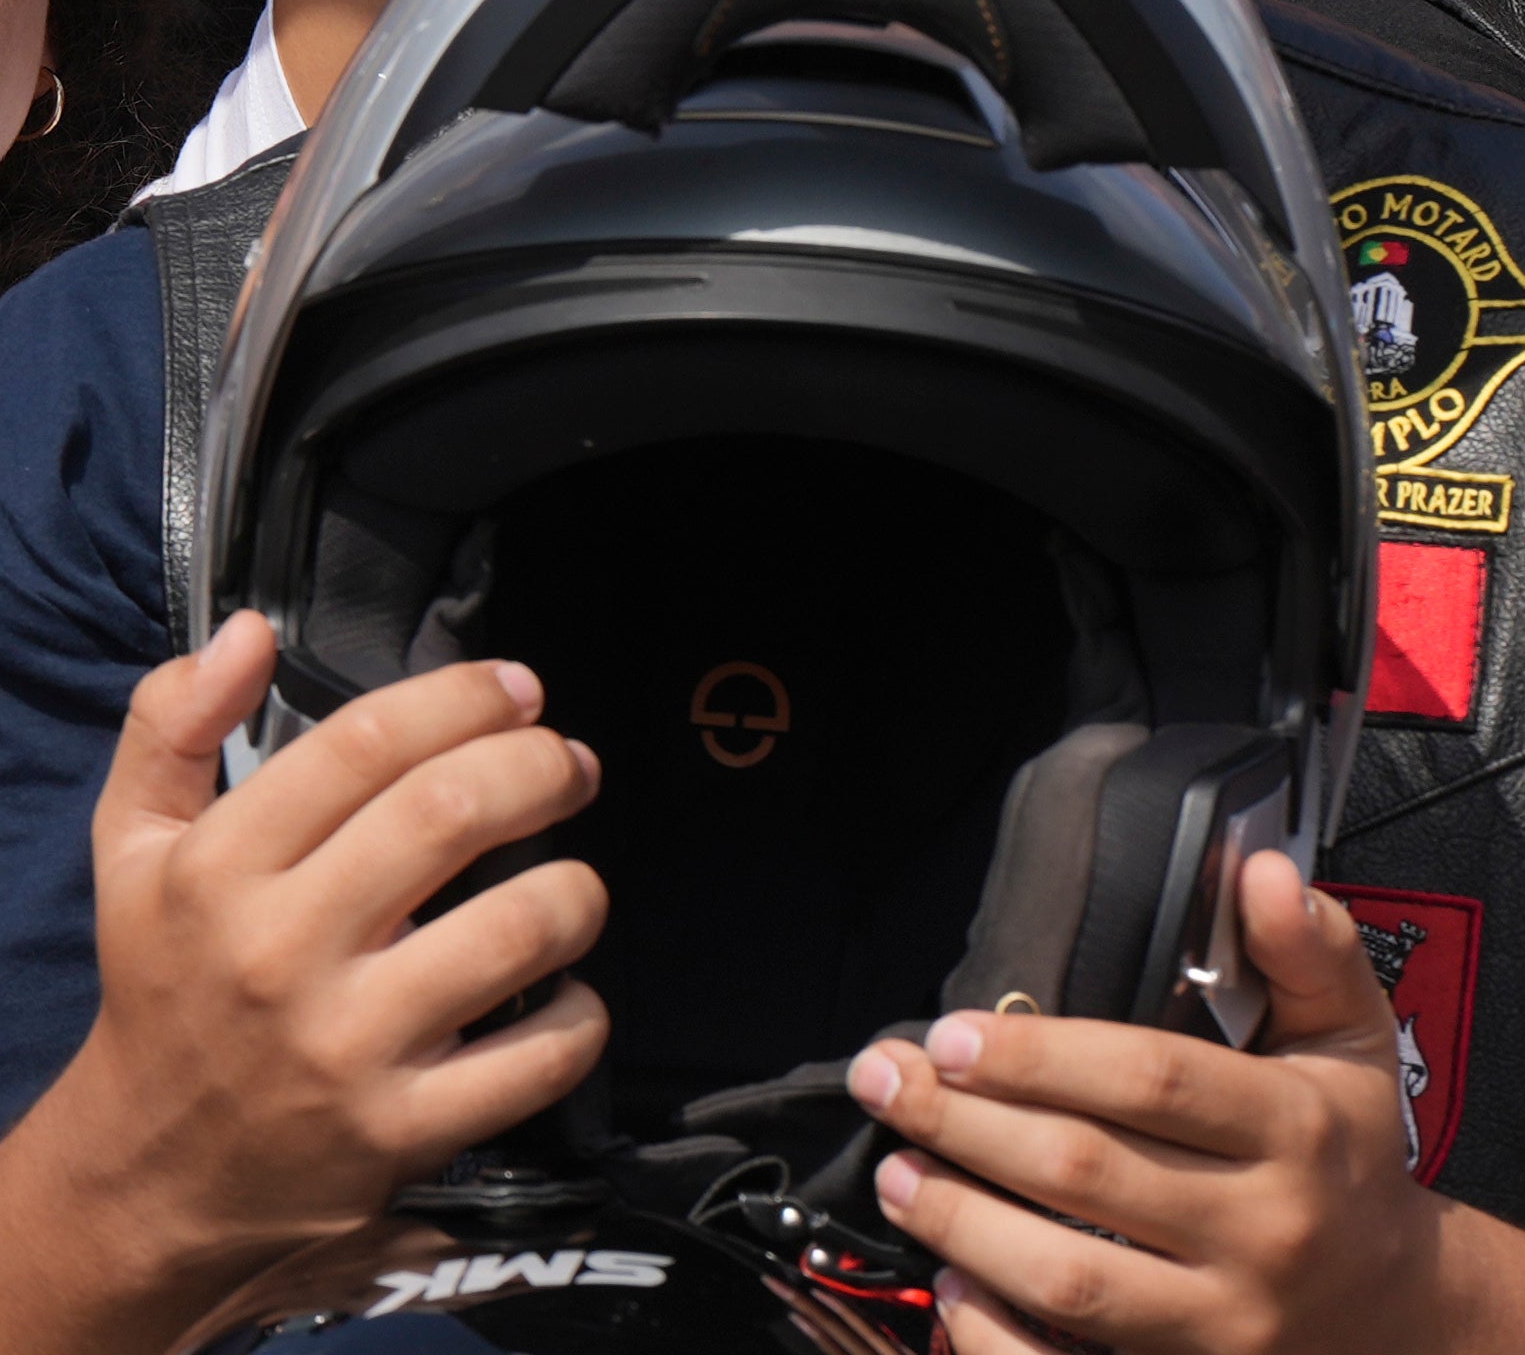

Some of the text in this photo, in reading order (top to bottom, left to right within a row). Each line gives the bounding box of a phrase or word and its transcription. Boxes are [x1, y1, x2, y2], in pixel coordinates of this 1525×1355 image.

[1380, 192, 1502, 283] MOTARD
[1367, 377, 1408, 401] RA
[1396, 480, 1494, 518] PRAZER
[363, 1249, 676, 1321] SMK
